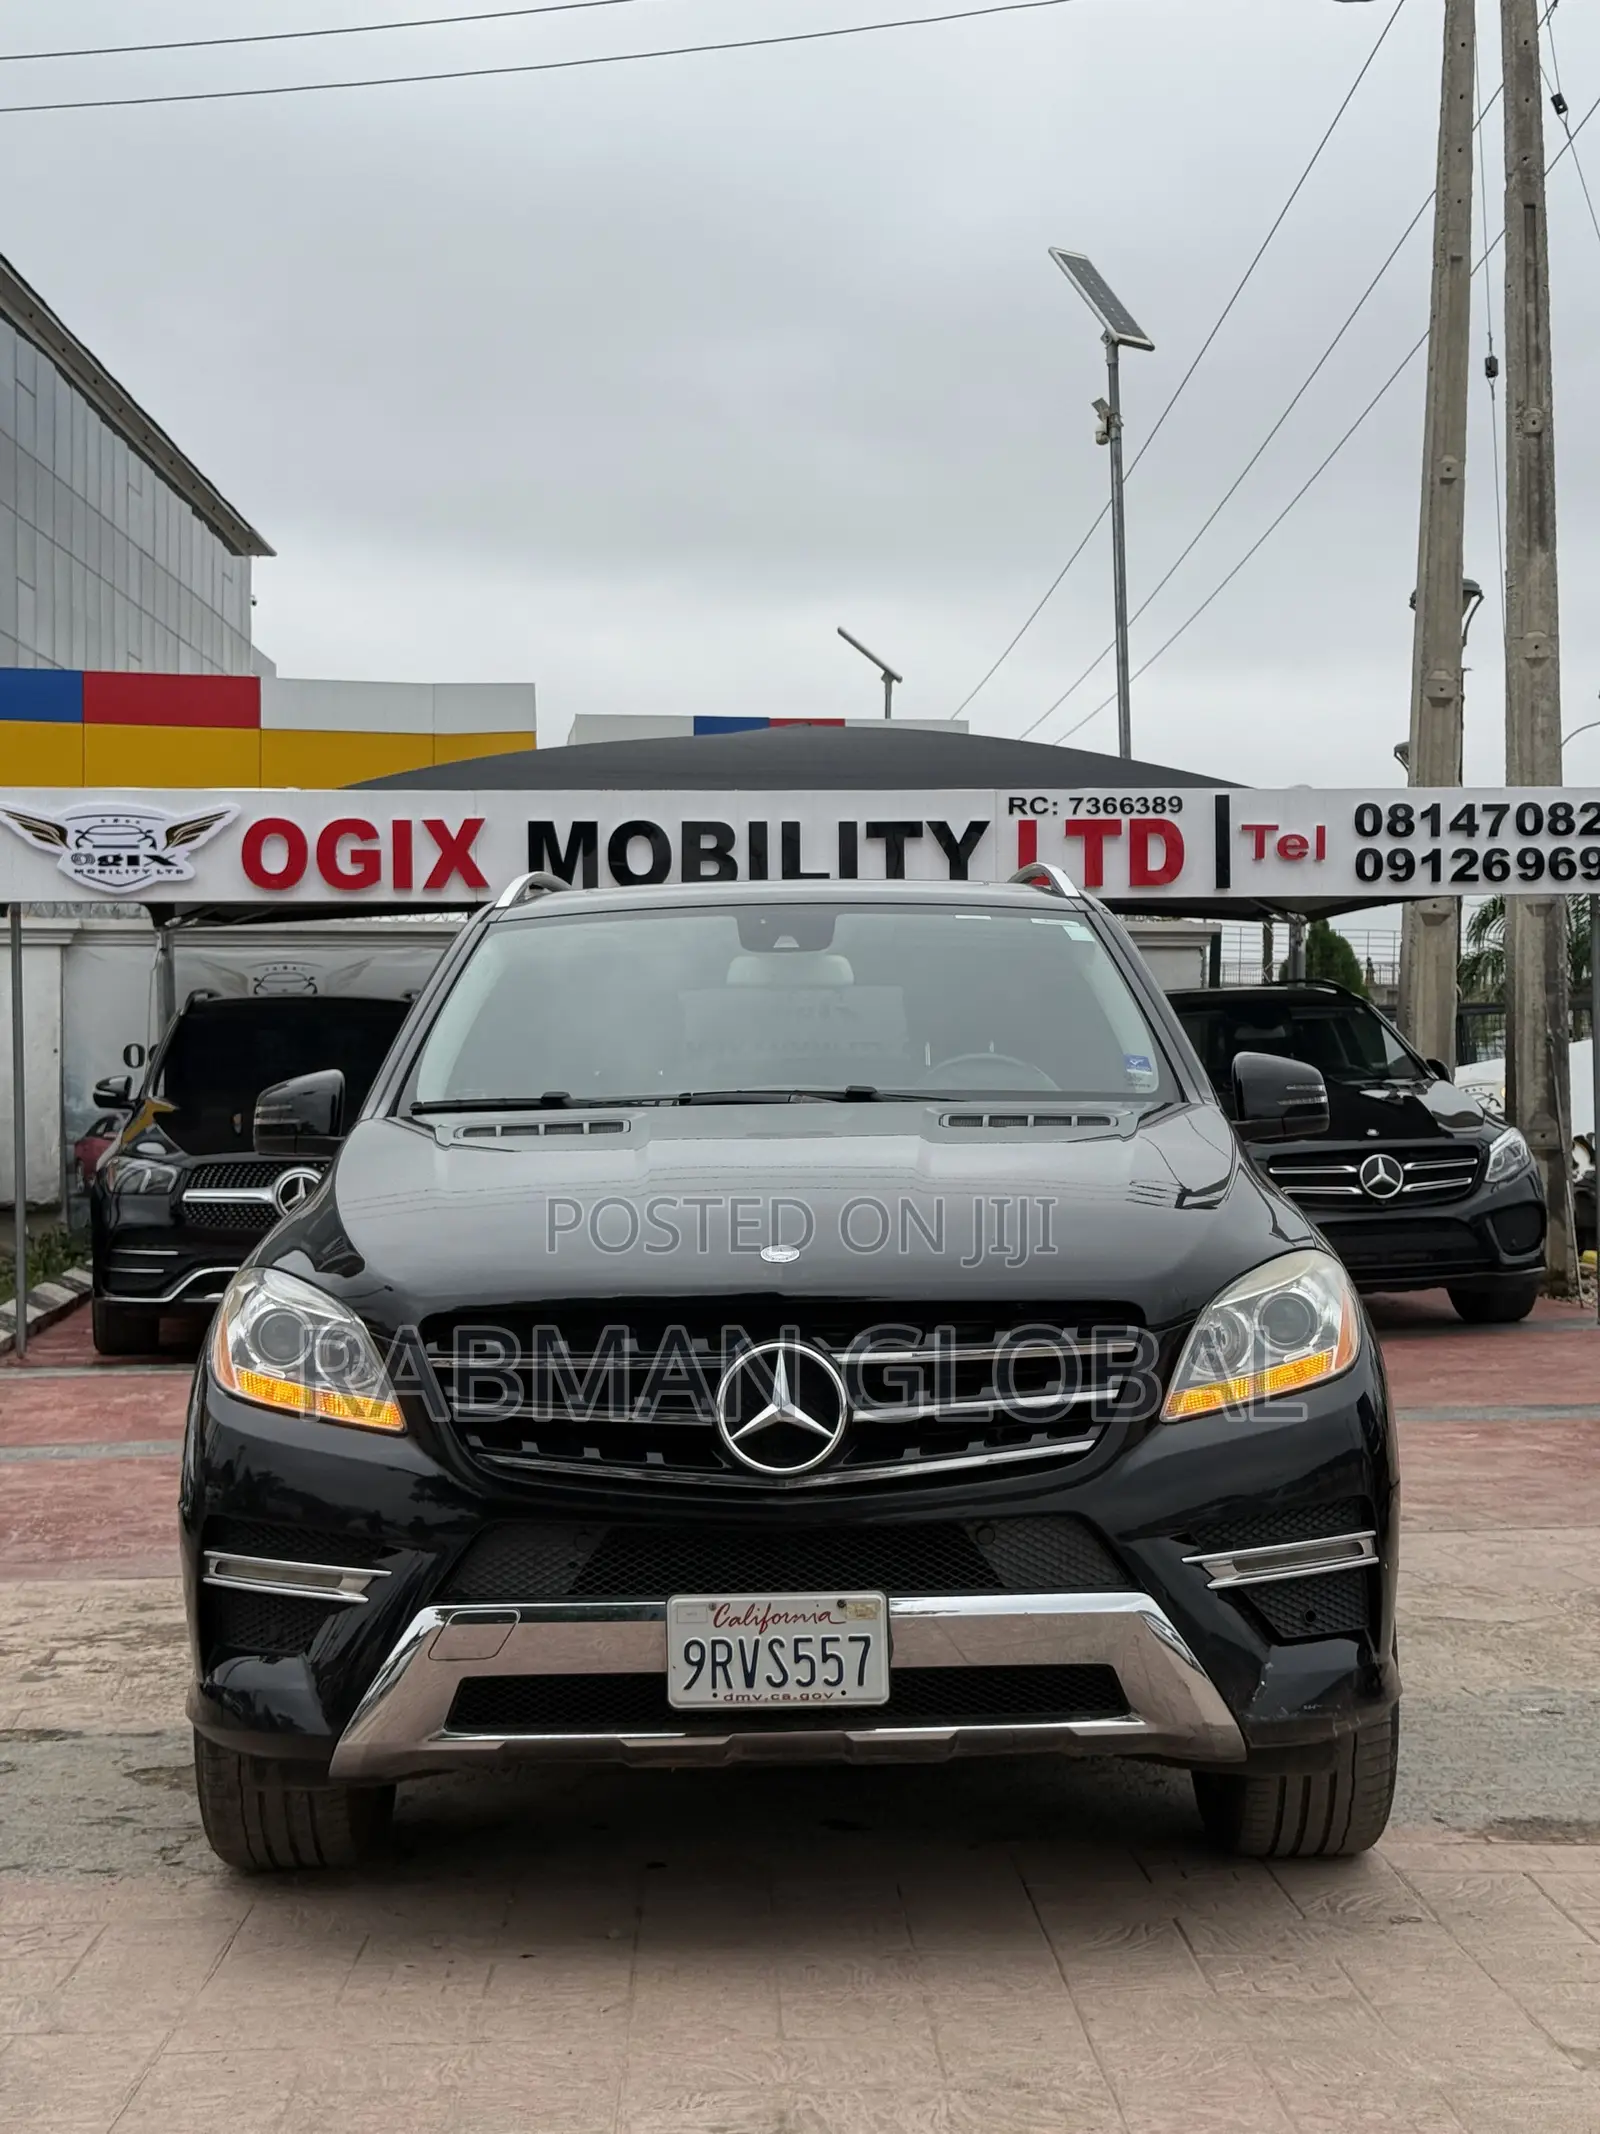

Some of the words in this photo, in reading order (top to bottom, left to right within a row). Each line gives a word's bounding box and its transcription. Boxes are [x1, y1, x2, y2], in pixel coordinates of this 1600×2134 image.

[1008, 796, 1059, 815] RC:
[1068, 795, 1184, 816] 7366389
[1354, 802, 1600, 838] 08147082
[241, 817, 491, 891] OGIX
[527, 820, 991, 889] MOBILITY
[1241, 824, 1327, 862] Tel
[1354, 847, 1600, 883] 09126969
[713, 1602, 847, 1635] California
[683, 1635, 872, 1690] 9RVS557
[723, 1691, 835, 1704] dmv.ca.gov
